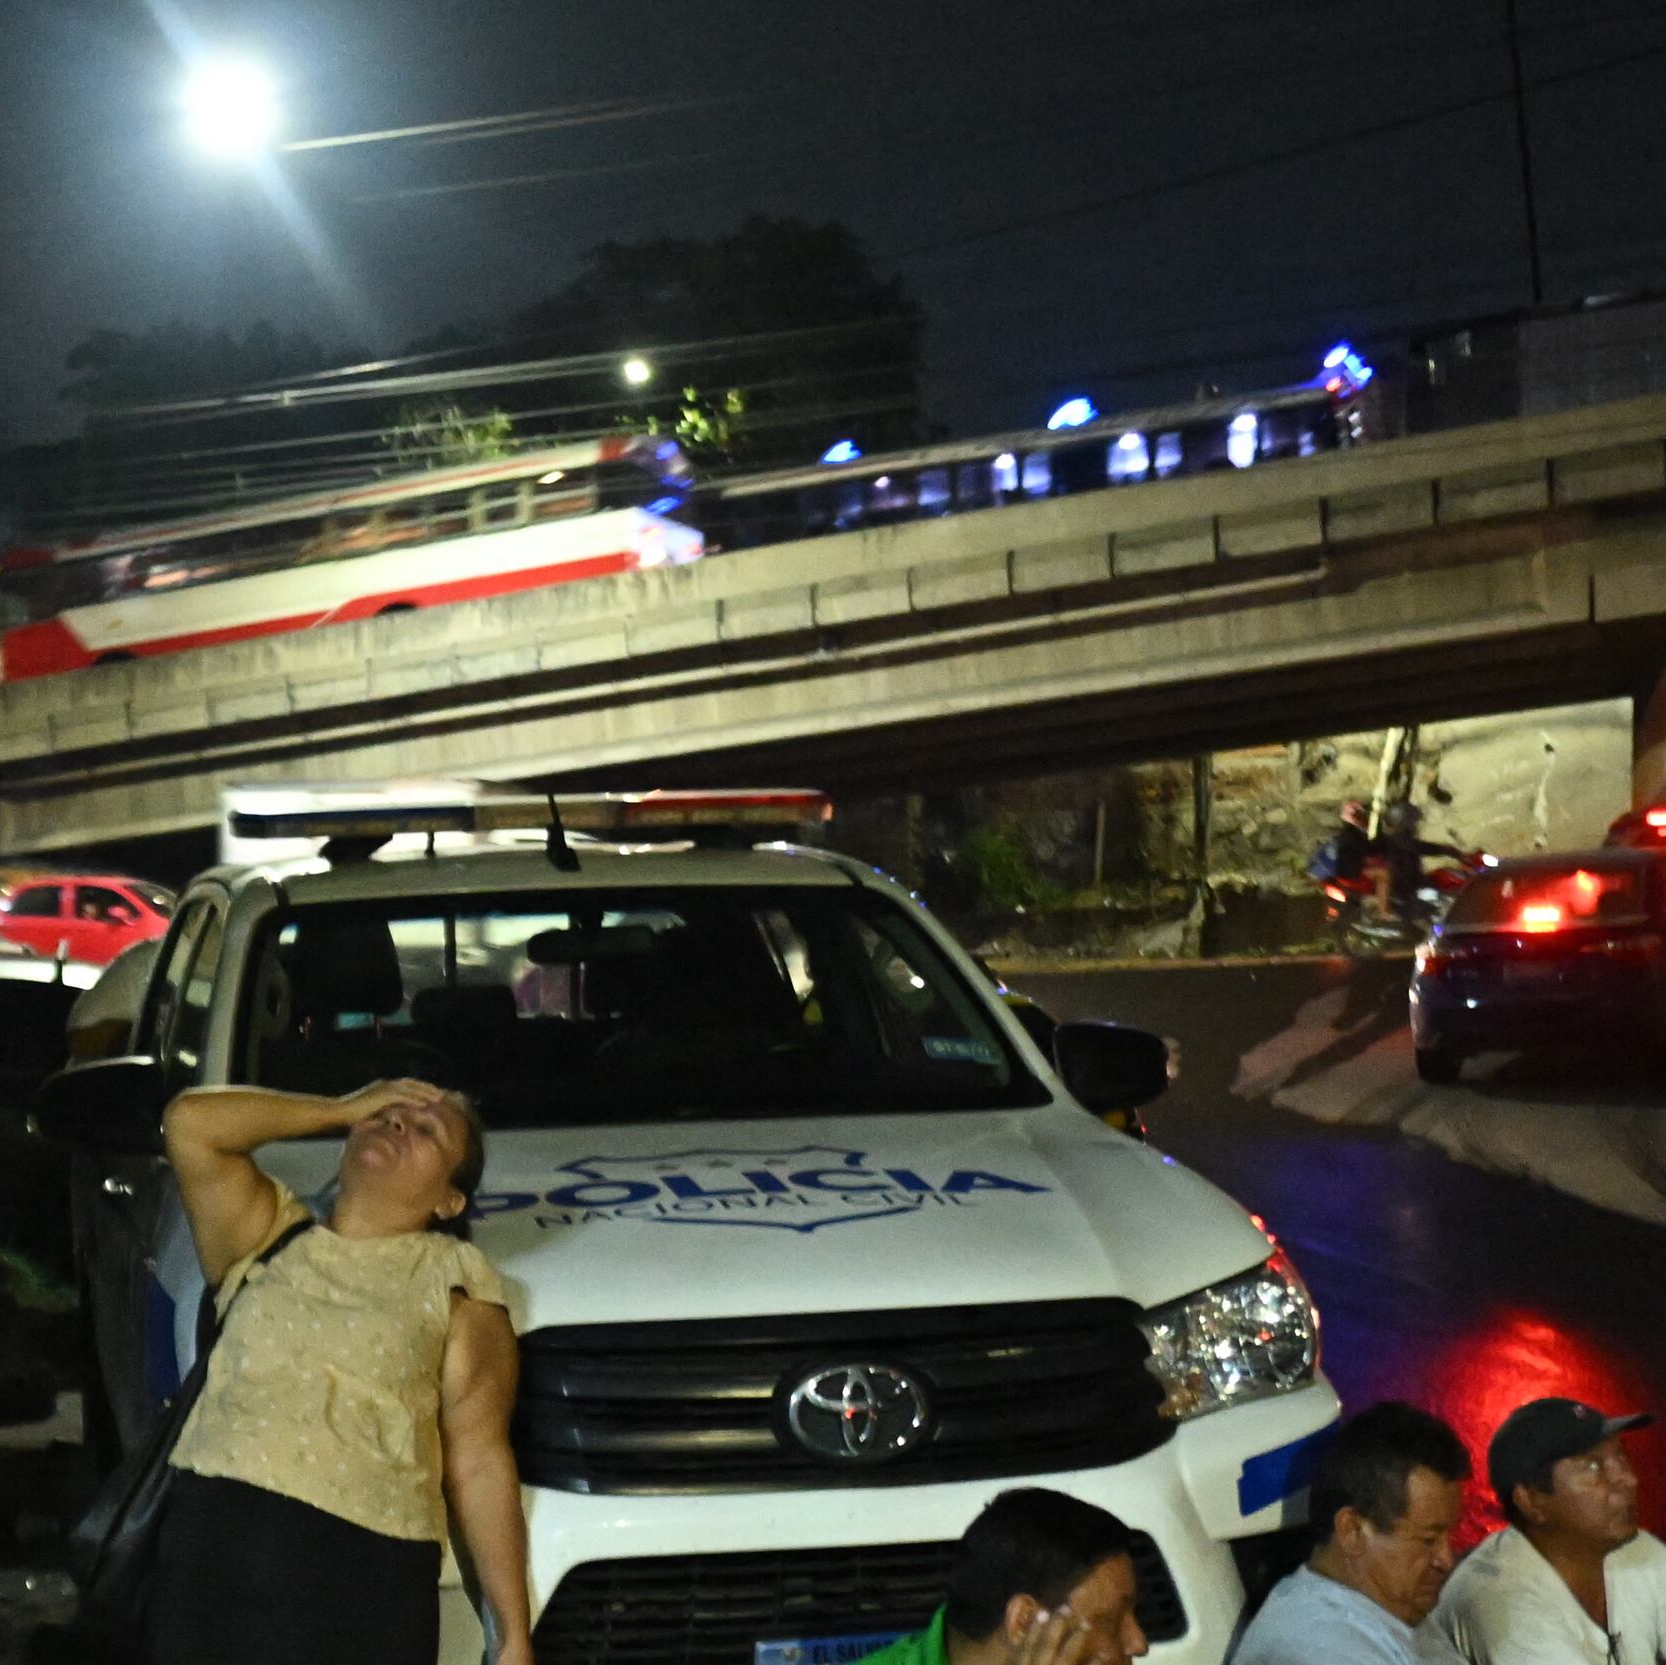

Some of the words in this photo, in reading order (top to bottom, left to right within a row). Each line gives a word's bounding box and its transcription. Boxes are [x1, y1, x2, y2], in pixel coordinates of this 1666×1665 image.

[471, 1169, 1052, 1219] POLICIA
[534, 1193, 829, 1229] NACIONAL
[840, 1192, 980, 1207] CIVIL
